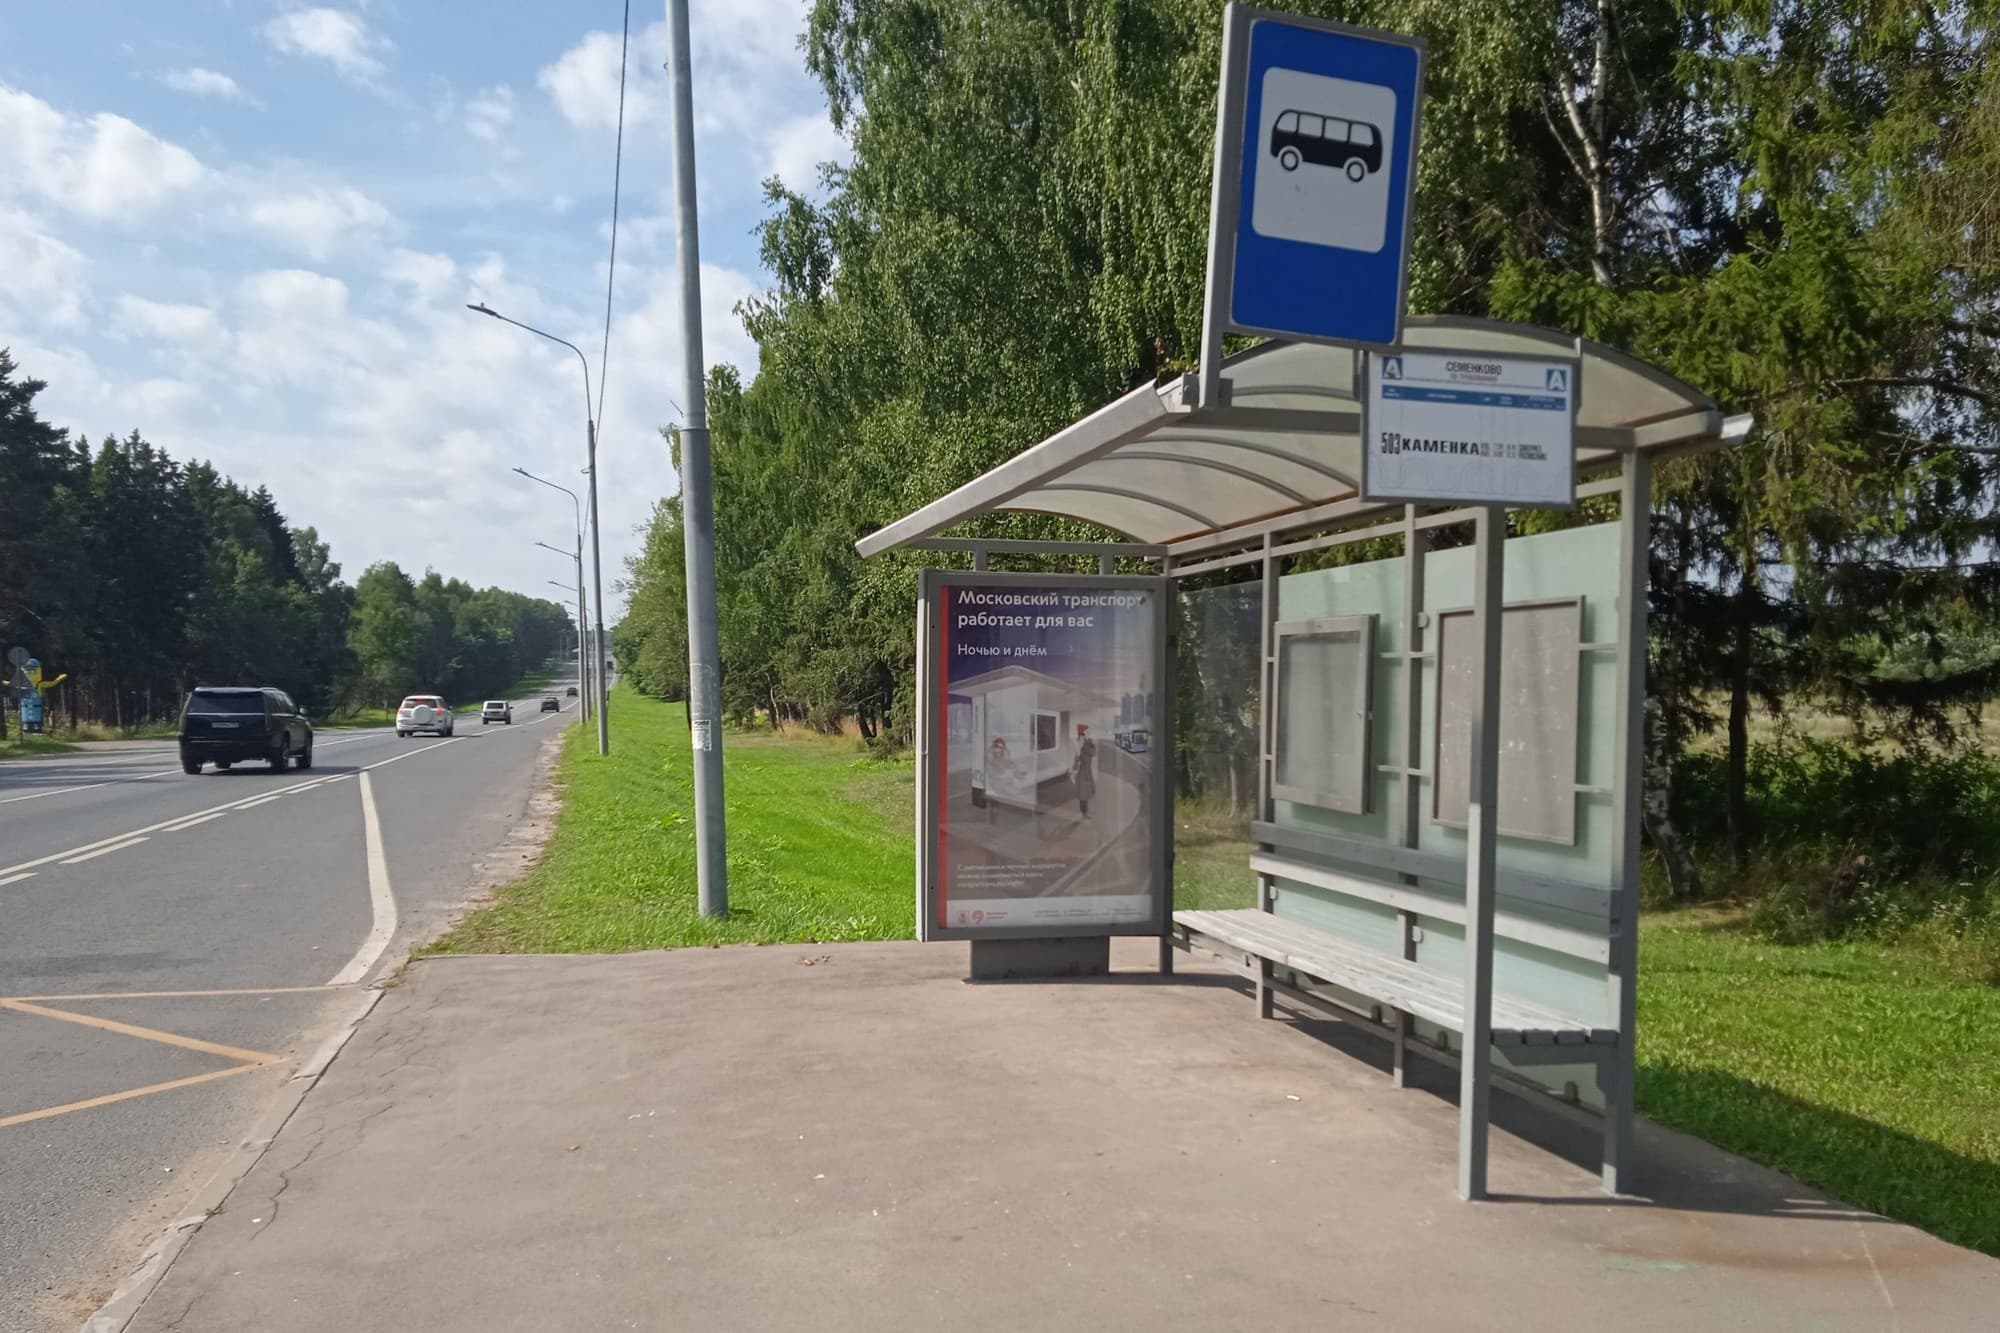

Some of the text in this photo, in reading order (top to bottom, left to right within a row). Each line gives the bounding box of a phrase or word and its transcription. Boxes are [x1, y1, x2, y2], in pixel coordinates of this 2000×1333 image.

[1446, 361, 1502, 375] СЕМЕНКОВО
[1381, 432, 1401, 455] 503
[1402, 437, 1480, 455] КАМЕНКА
[958, 590, 1143, 608] Московский транспорт
[958, 612, 1093, 628] работает для вас
[958, 644, 1047, 657] Ночью и днём
